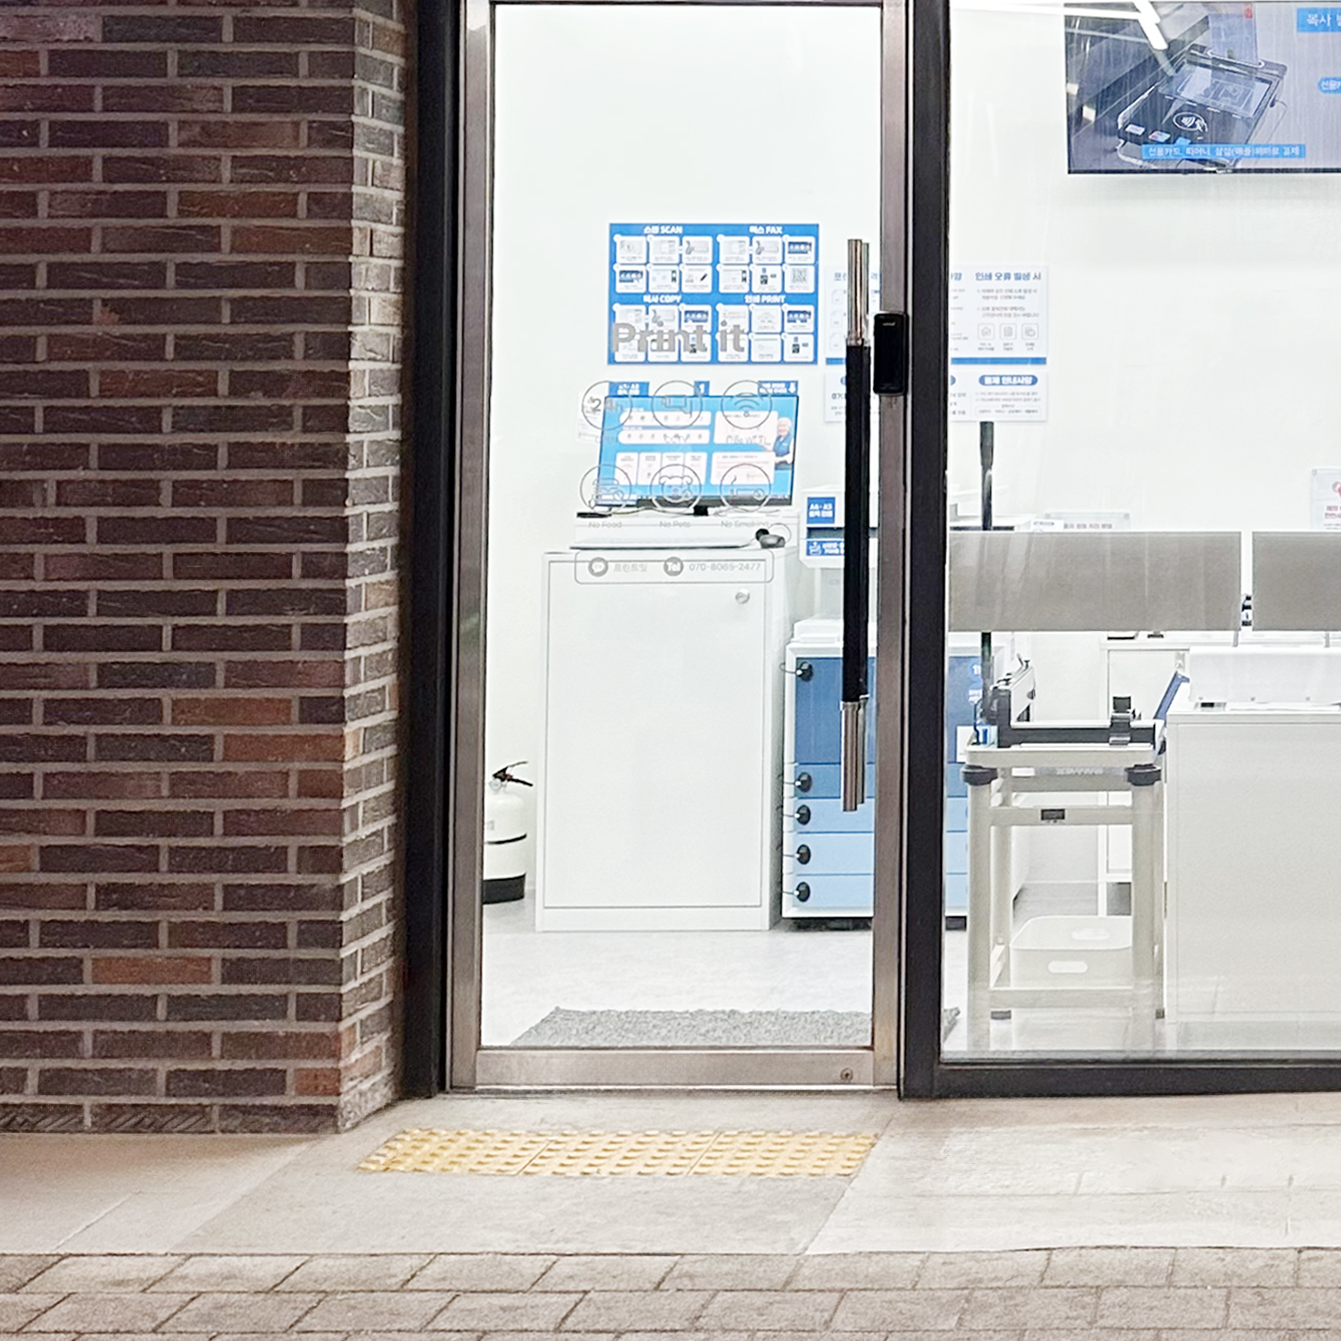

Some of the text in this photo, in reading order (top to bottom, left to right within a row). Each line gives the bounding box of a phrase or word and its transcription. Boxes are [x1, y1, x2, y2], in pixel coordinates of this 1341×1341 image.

[1307, 13, 1332, 27] 복사
[660, 225, 683, 235] SCAN
[766, 226, 783, 234] FAX
[659, 295, 682, 304] COPY
[761, 295, 786, 304] PRINT
[612, 319, 745, 353] Print it
[588, 521, 622, 529] No Food
[659, 521, 691, 529] No Pets
[721, 521, 769, 530] No Smoking
[666, 561, 761, 572] Tel 070-8065-2477
